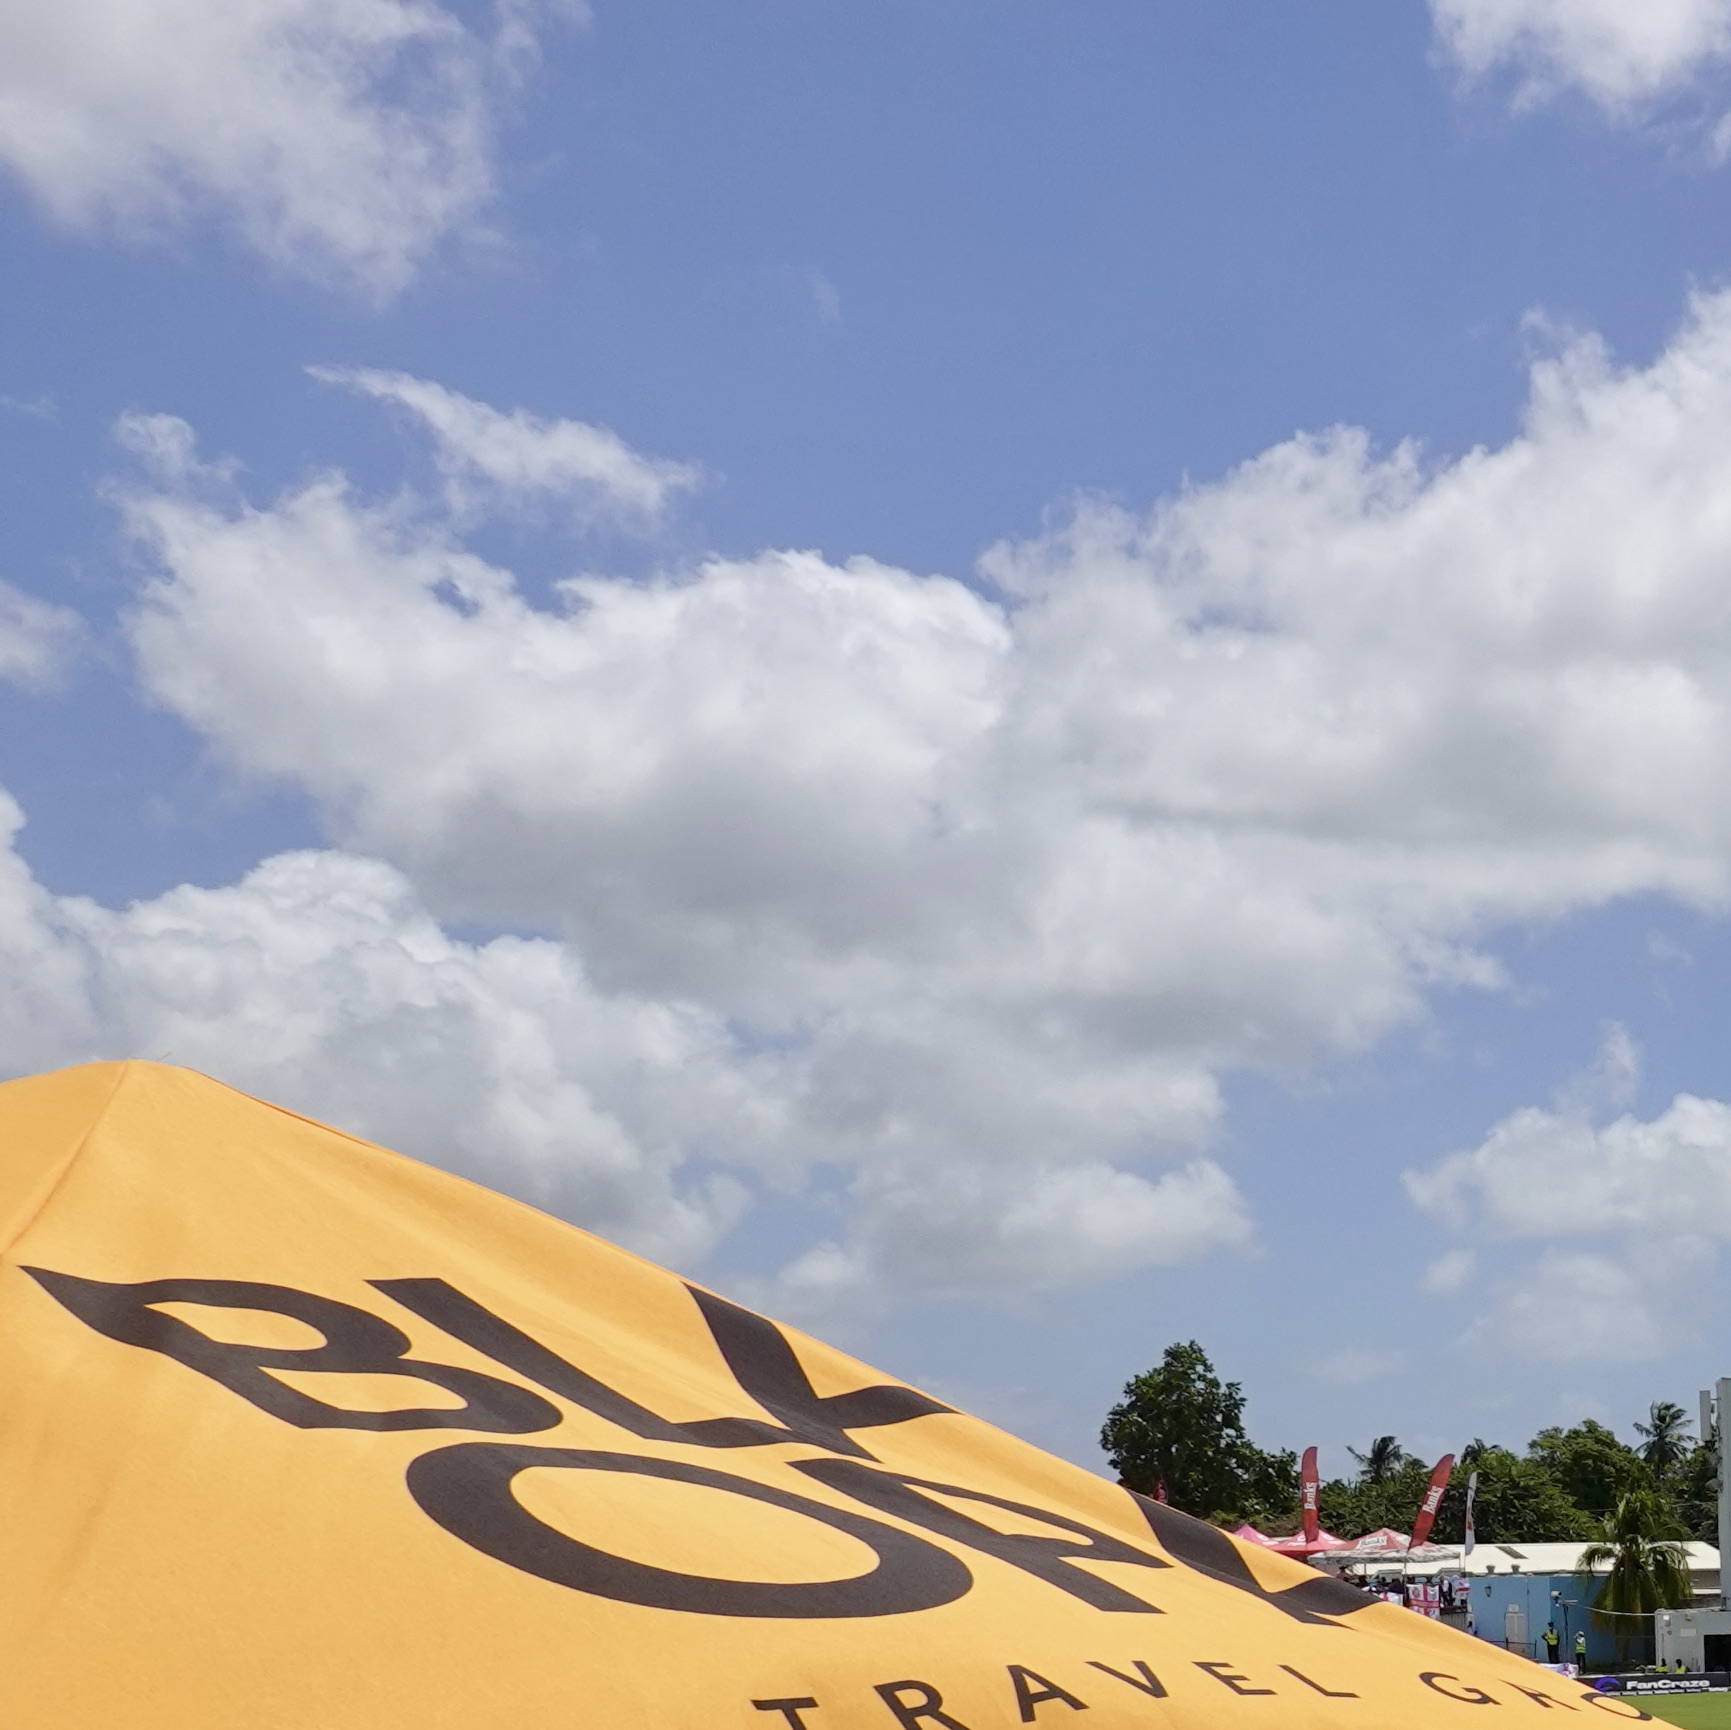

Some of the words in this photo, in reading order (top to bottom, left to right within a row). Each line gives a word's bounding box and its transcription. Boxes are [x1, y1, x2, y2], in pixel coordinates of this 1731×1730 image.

[1304, 1482, 1317, 1510] Banks
[1422, 1485, 1444, 1515] Banks
[1418, 1671, 1653, 1722] GRO
[1626, 1679, 1710, 1690] FanCraze
